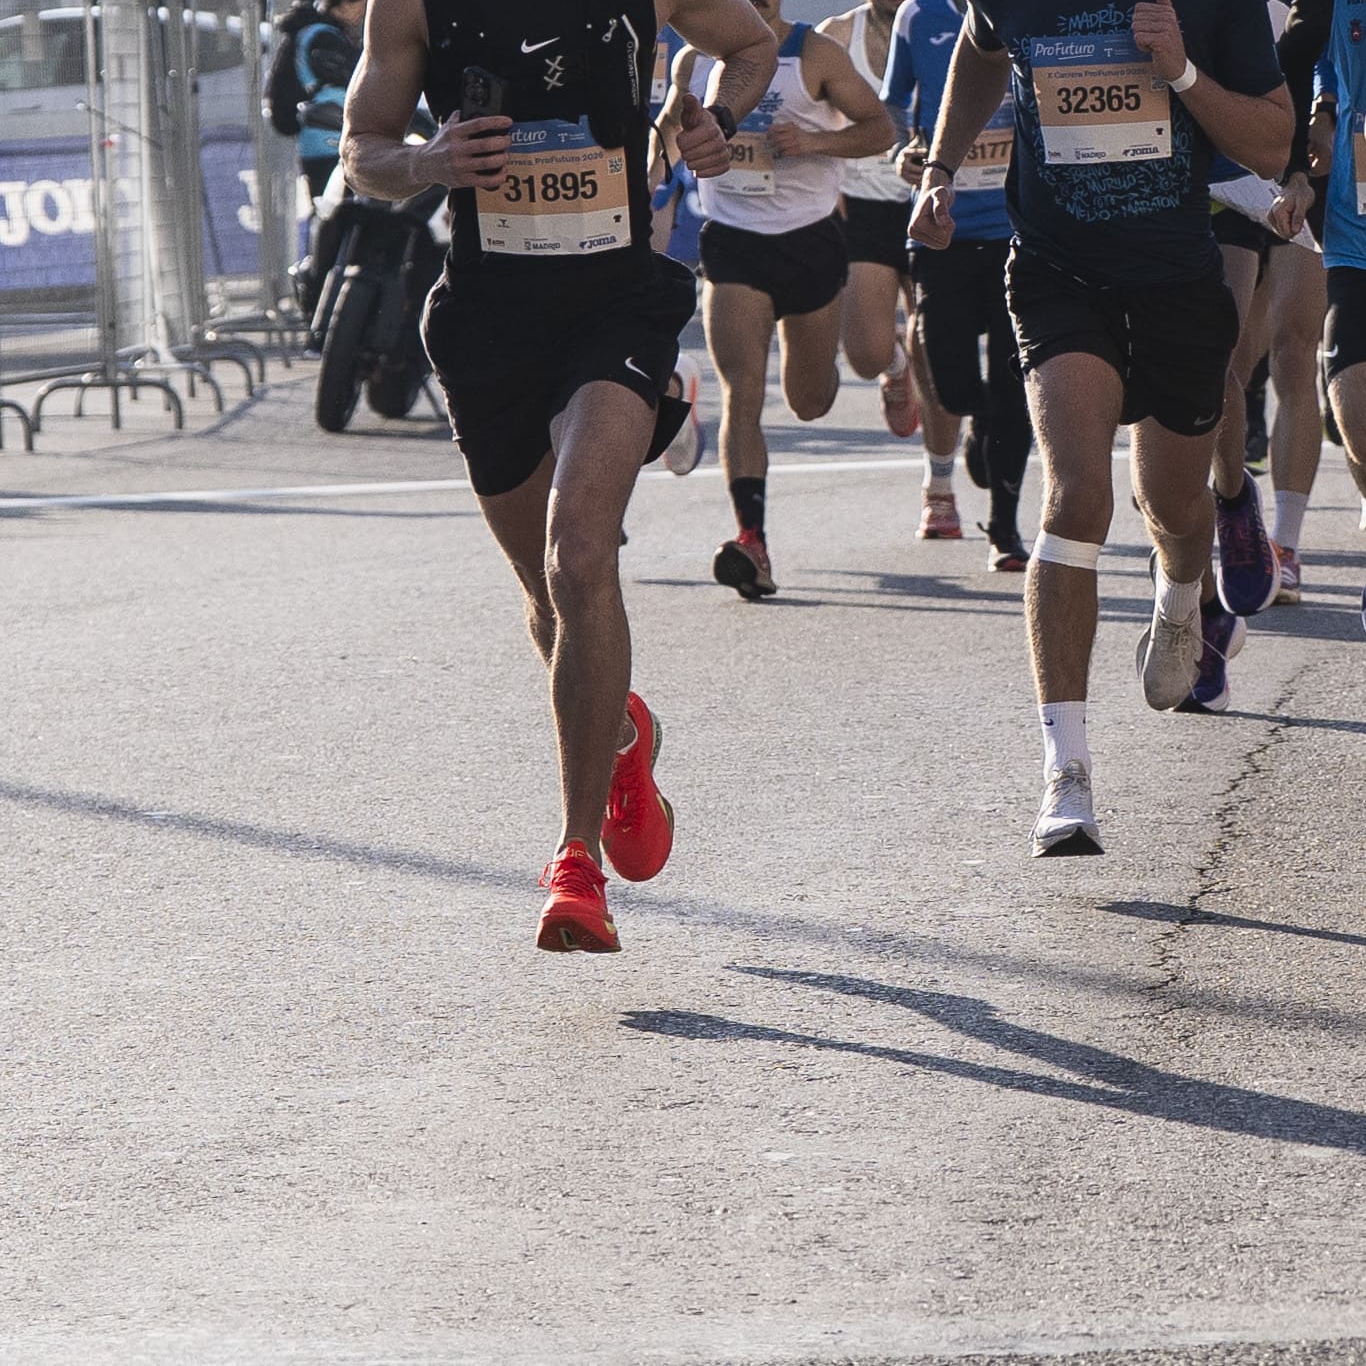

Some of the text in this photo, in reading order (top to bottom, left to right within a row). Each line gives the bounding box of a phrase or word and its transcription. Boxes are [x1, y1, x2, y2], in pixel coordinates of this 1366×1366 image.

[1034, 42, 1096, 57] ProFuturo
[1056, 84, 1141, 115] 32365
[503, 169, 599, 204] 31895
